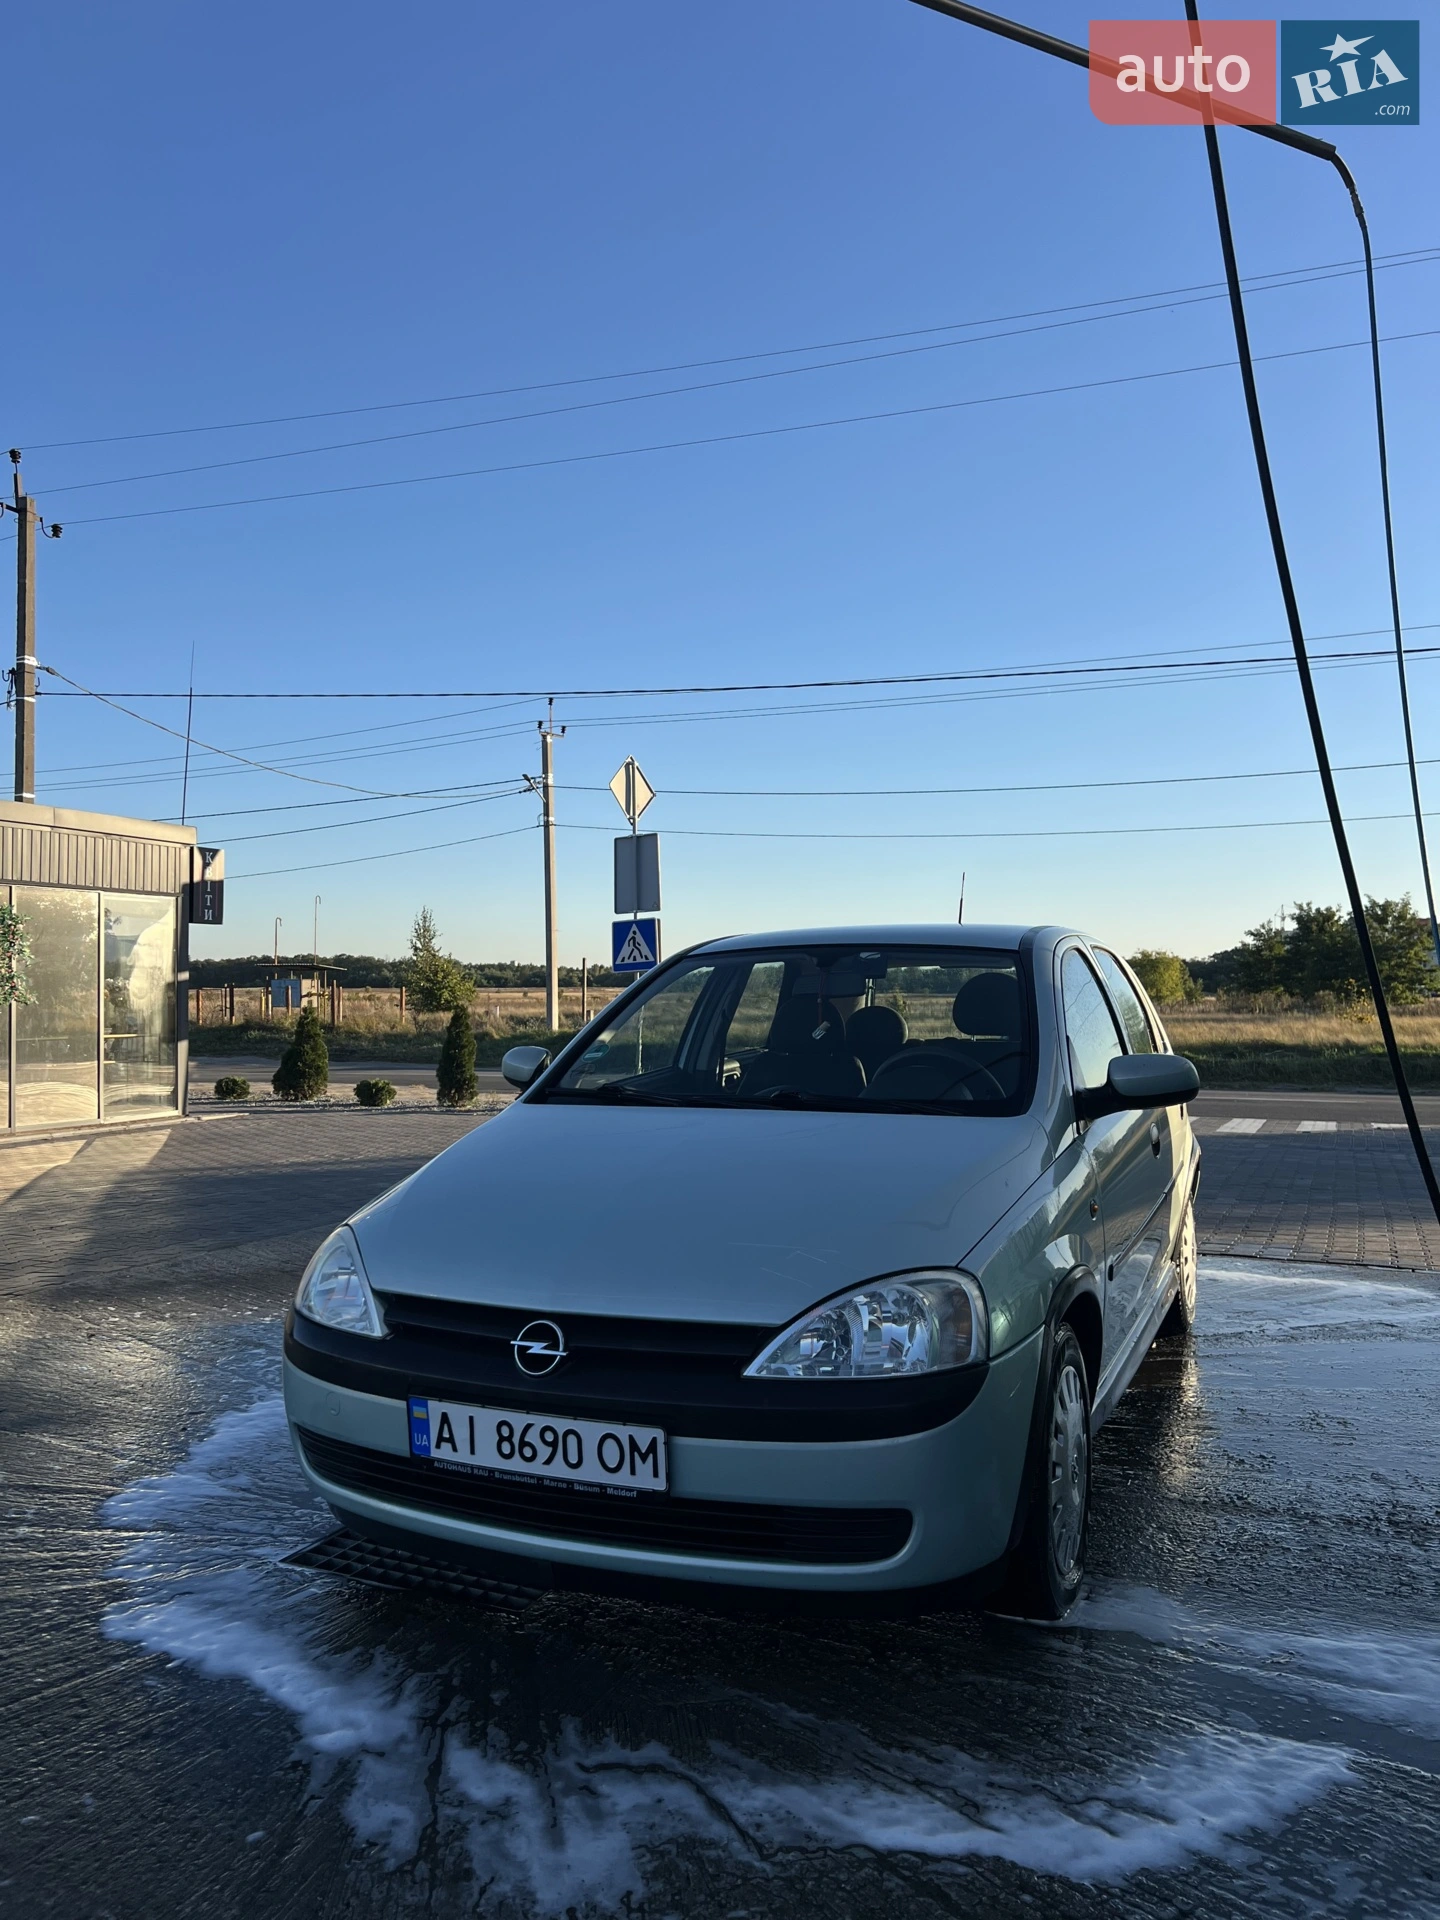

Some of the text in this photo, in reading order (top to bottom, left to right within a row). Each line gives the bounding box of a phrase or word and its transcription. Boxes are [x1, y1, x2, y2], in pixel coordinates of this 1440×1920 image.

[414, 1434, 429, 1447] UA
[434, 1411, 660, 1479] AI 8690 OM
[433, 1460, 472, 1474] AUTOHAUS
[543, 1478, 567, 1489] Marne
[573, 1482, 600, 1493] Büsum
[606, 1487, 637, 1498] Meldorf
